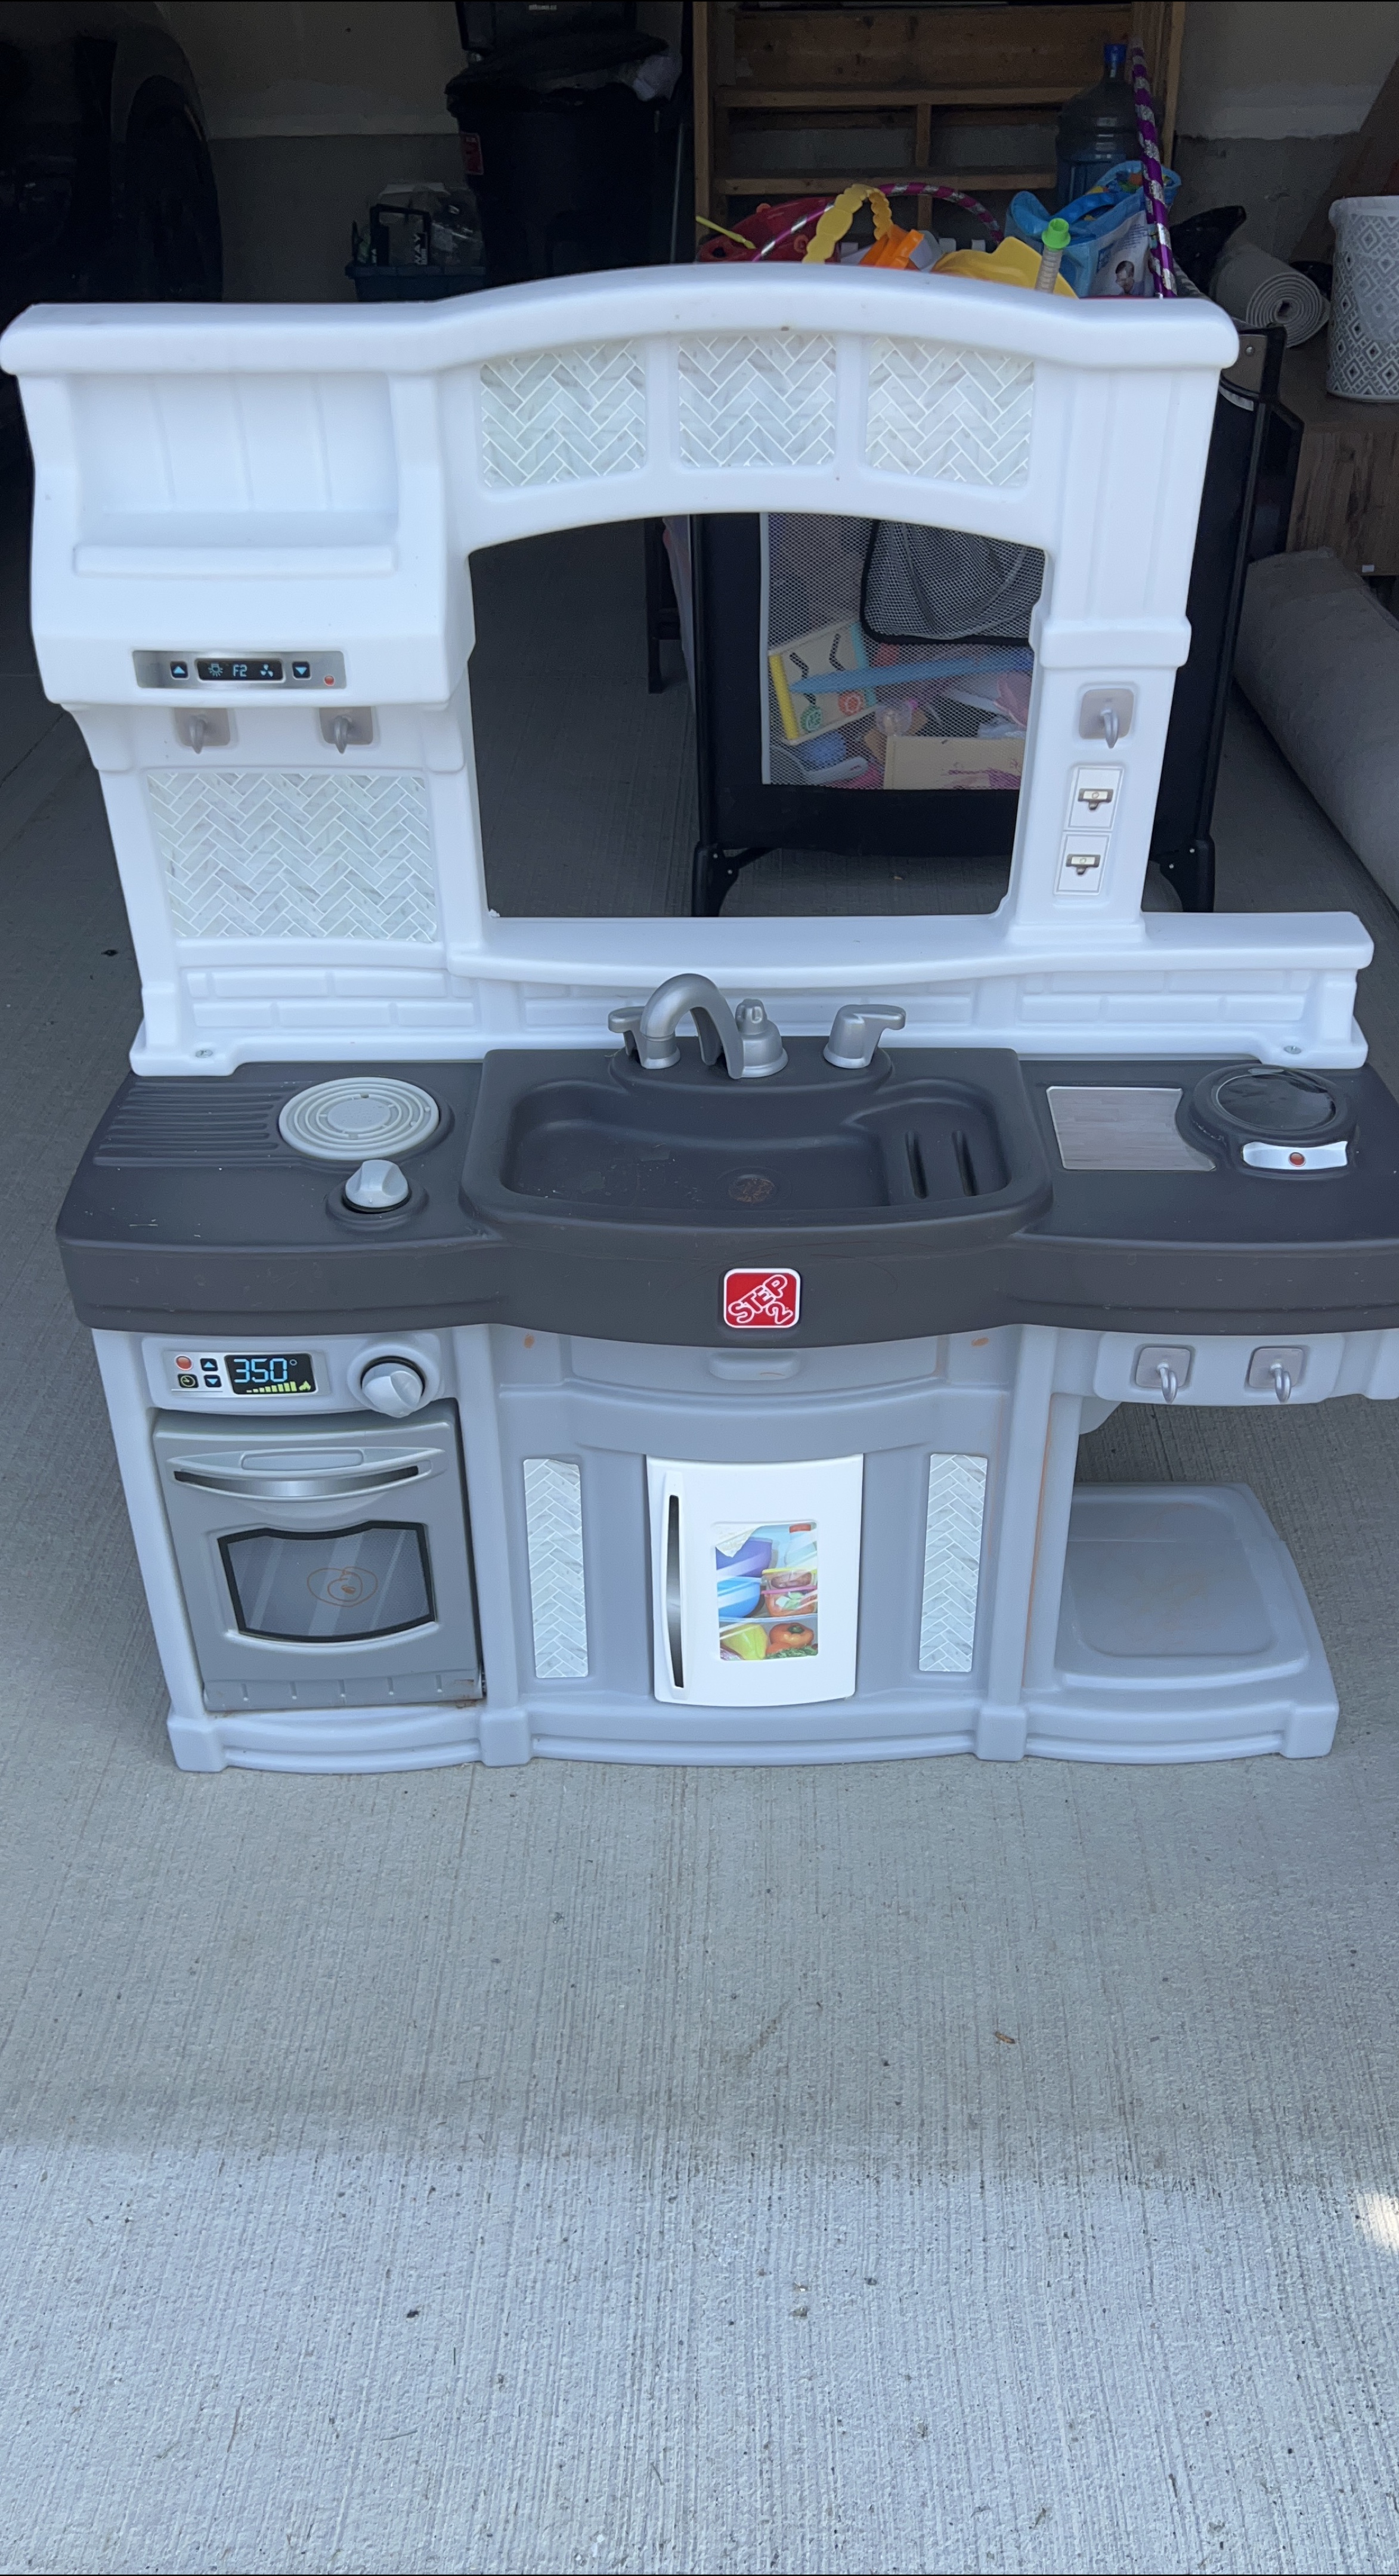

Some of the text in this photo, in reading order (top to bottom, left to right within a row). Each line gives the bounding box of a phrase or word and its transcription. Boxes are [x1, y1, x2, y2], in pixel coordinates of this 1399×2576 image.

[233, 664, 247, 677] F2
[728, 1274, 788, 1323] STEP
[765, 1302, 794, 1324] 2
